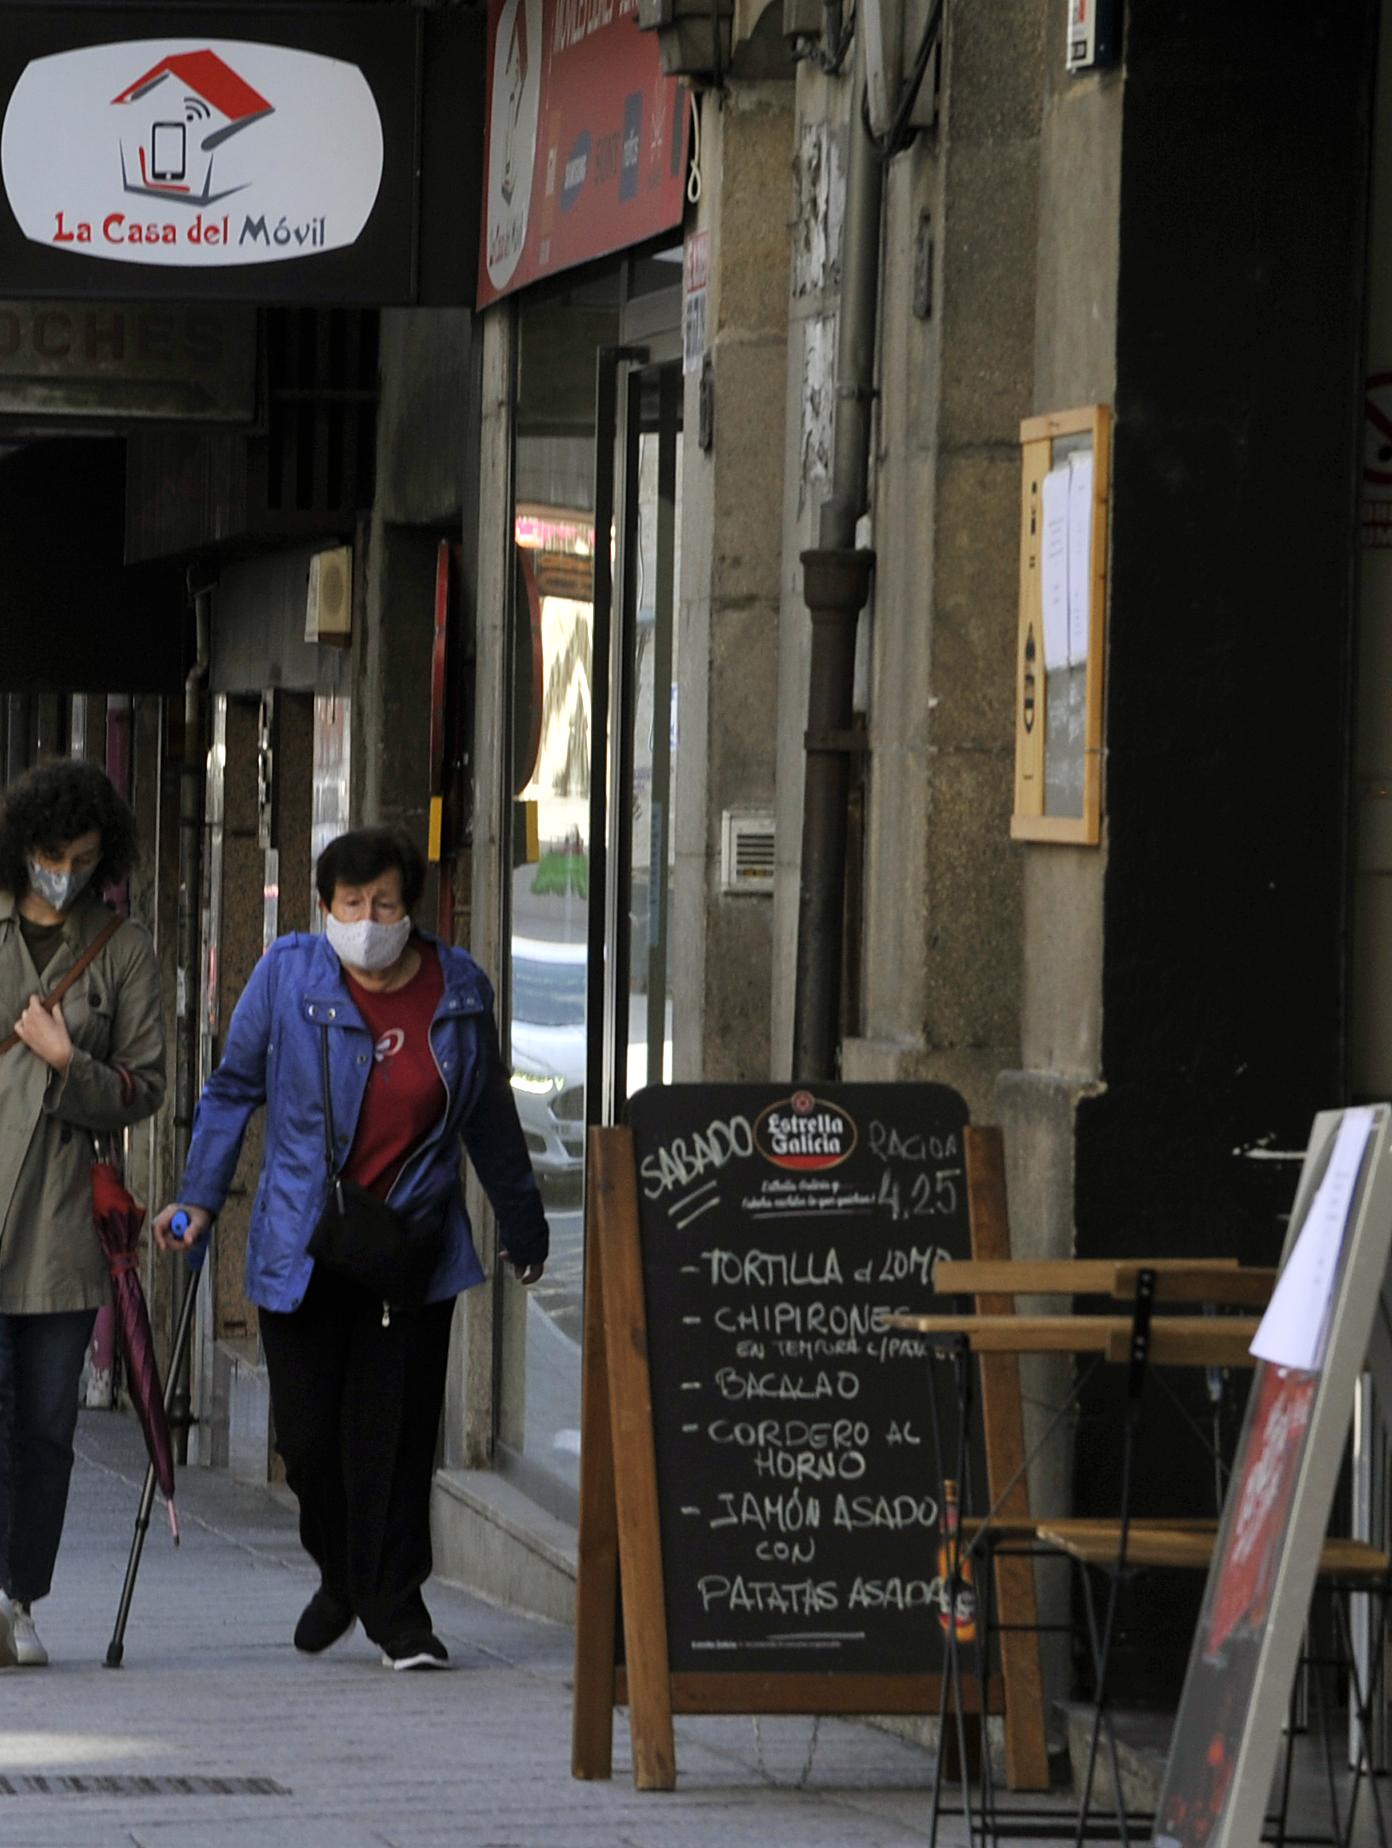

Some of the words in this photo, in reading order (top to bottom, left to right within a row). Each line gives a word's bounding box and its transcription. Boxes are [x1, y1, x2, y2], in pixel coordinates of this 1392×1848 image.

[52, 211, 92, 243] La
[102, 212, 176, 245] Casa
[187, 215, 229, 246] del
[238, 214, 327, 247] Móvil
[767, 1113, 844, 1136] Estrella
[640, 1114, 755, 1200] SABADO
[771, 1134, 841, 1156] Galicia
[700, 1246, 844, 1287] TORTILLA
[715, 1366, 861, 1401] BACALAO
[708, 1418, 870, 1449] CORDERO
[885, 1419, 922, 1447] AL
[754, 1449, 867, 1483] HORNO
[833, 1492, 940, 1532] ASADO
[697, 1573, 839, 1616] PATATAS
